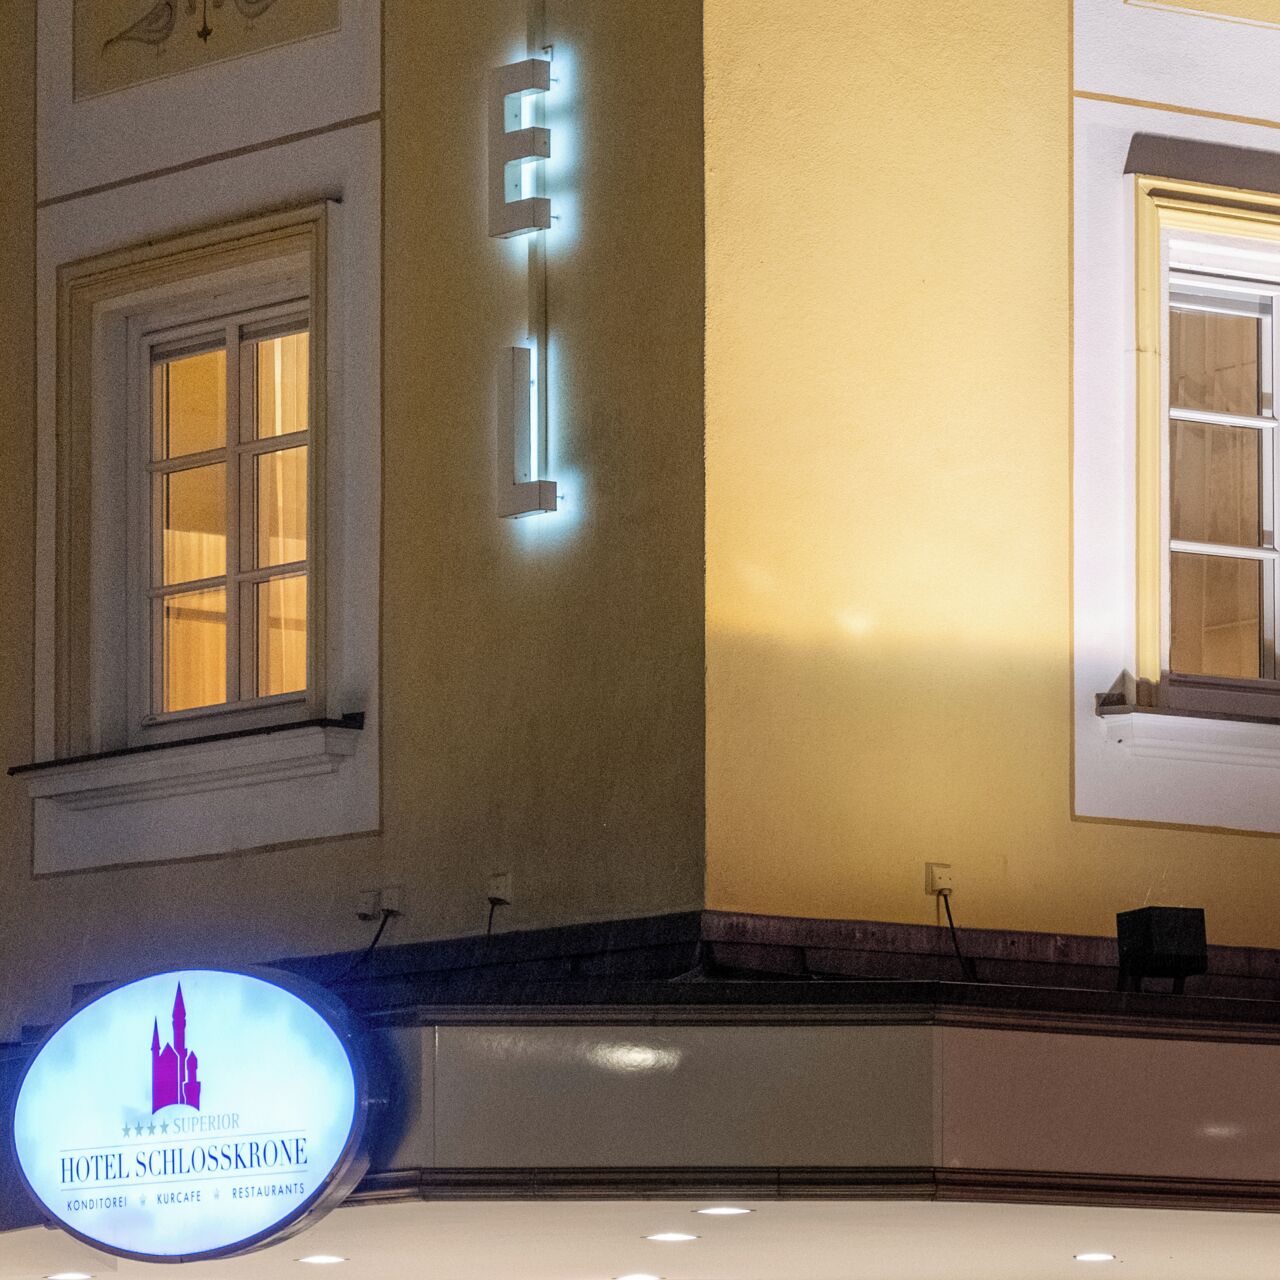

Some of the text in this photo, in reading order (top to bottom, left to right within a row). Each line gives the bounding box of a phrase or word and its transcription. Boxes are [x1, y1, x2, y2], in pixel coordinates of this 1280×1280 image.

[172, 1112, 240, 1135] SUPERIOR
[60, 1138, 308, 1184] HOTEL SCHLOSSKRONE
[67, 1182, 305, 1212] KONDITOREI KURCAFE RESTAURANTS
